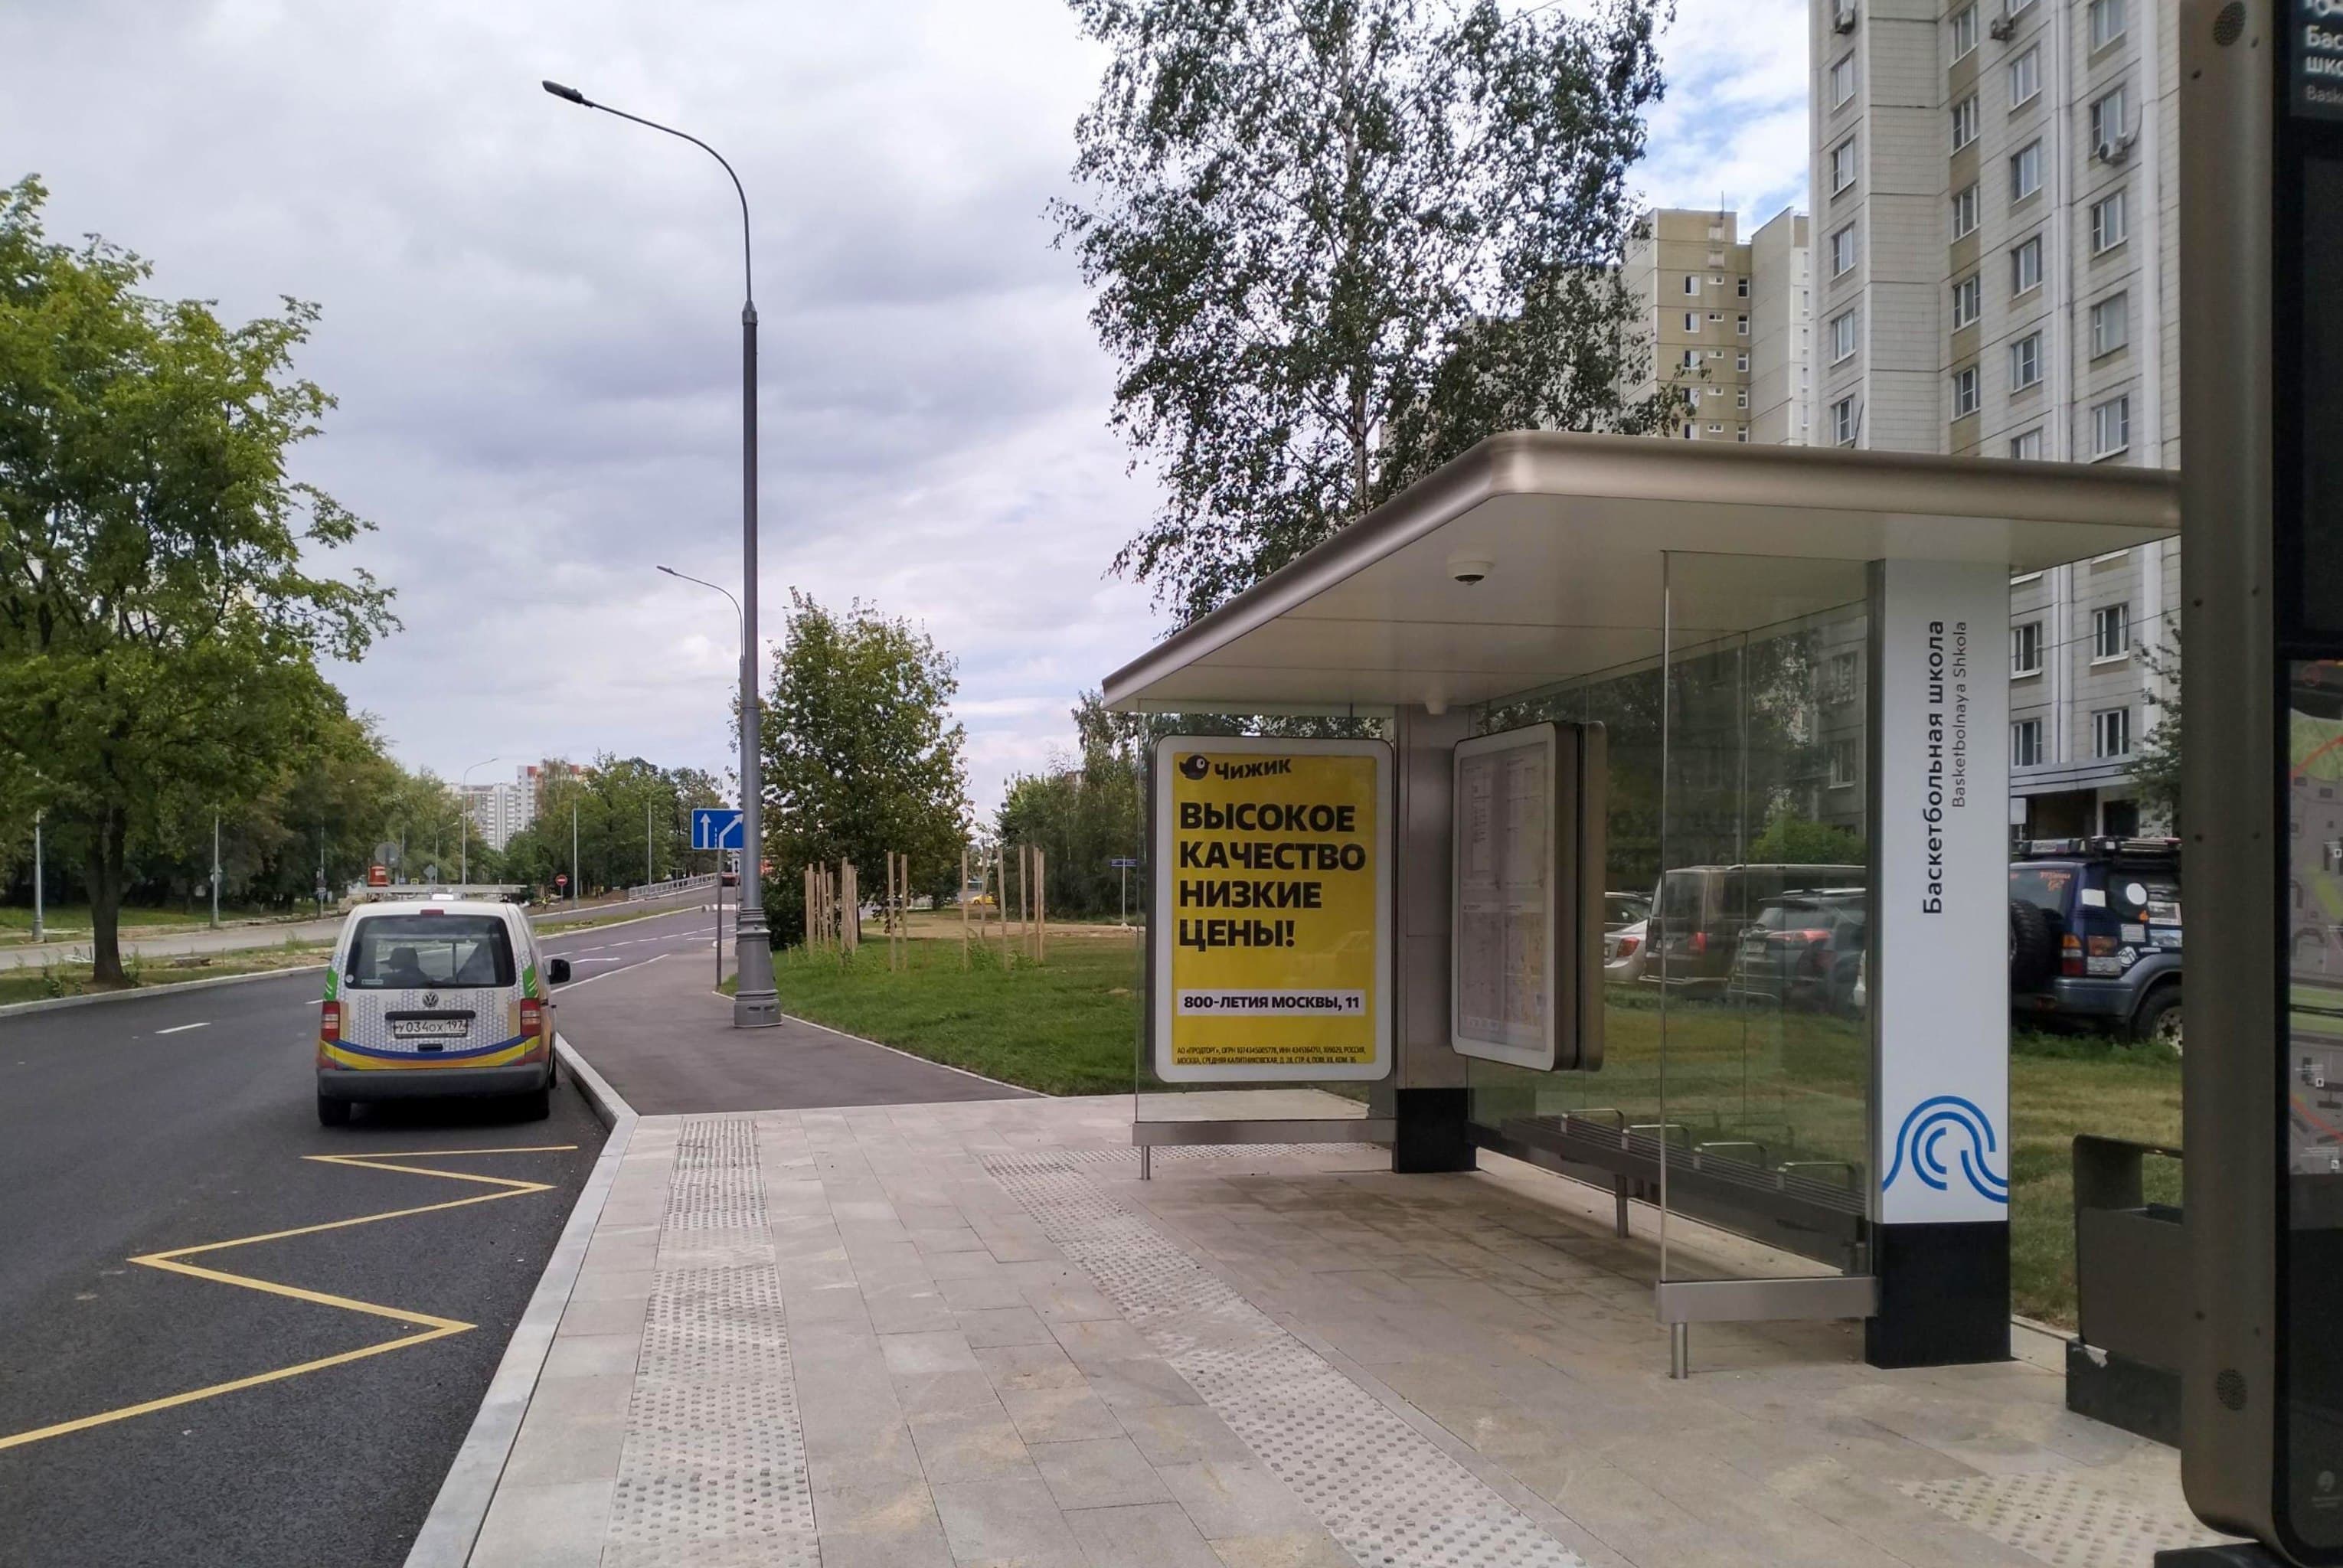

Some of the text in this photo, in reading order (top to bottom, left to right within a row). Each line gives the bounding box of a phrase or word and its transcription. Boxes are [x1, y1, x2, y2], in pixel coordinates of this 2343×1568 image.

[1952, 622, 1970, 808] Basketbolnaya Shkola
[1923, 621, 1944, 914] Баскетбольная школа
[1180, 802, 1355, 832] ВЫСОКОЕ
[1180, 841, 1367, 871] КАЧЕСТВО
[1180, 880, 1322, 909] НИЗКИЕ
[1179, 919, 1296, 952] ЦЕНЫ!
[1184, 996, 1359, 1011] 800-ЛЕТИЯ МОСКВЫ, 11
